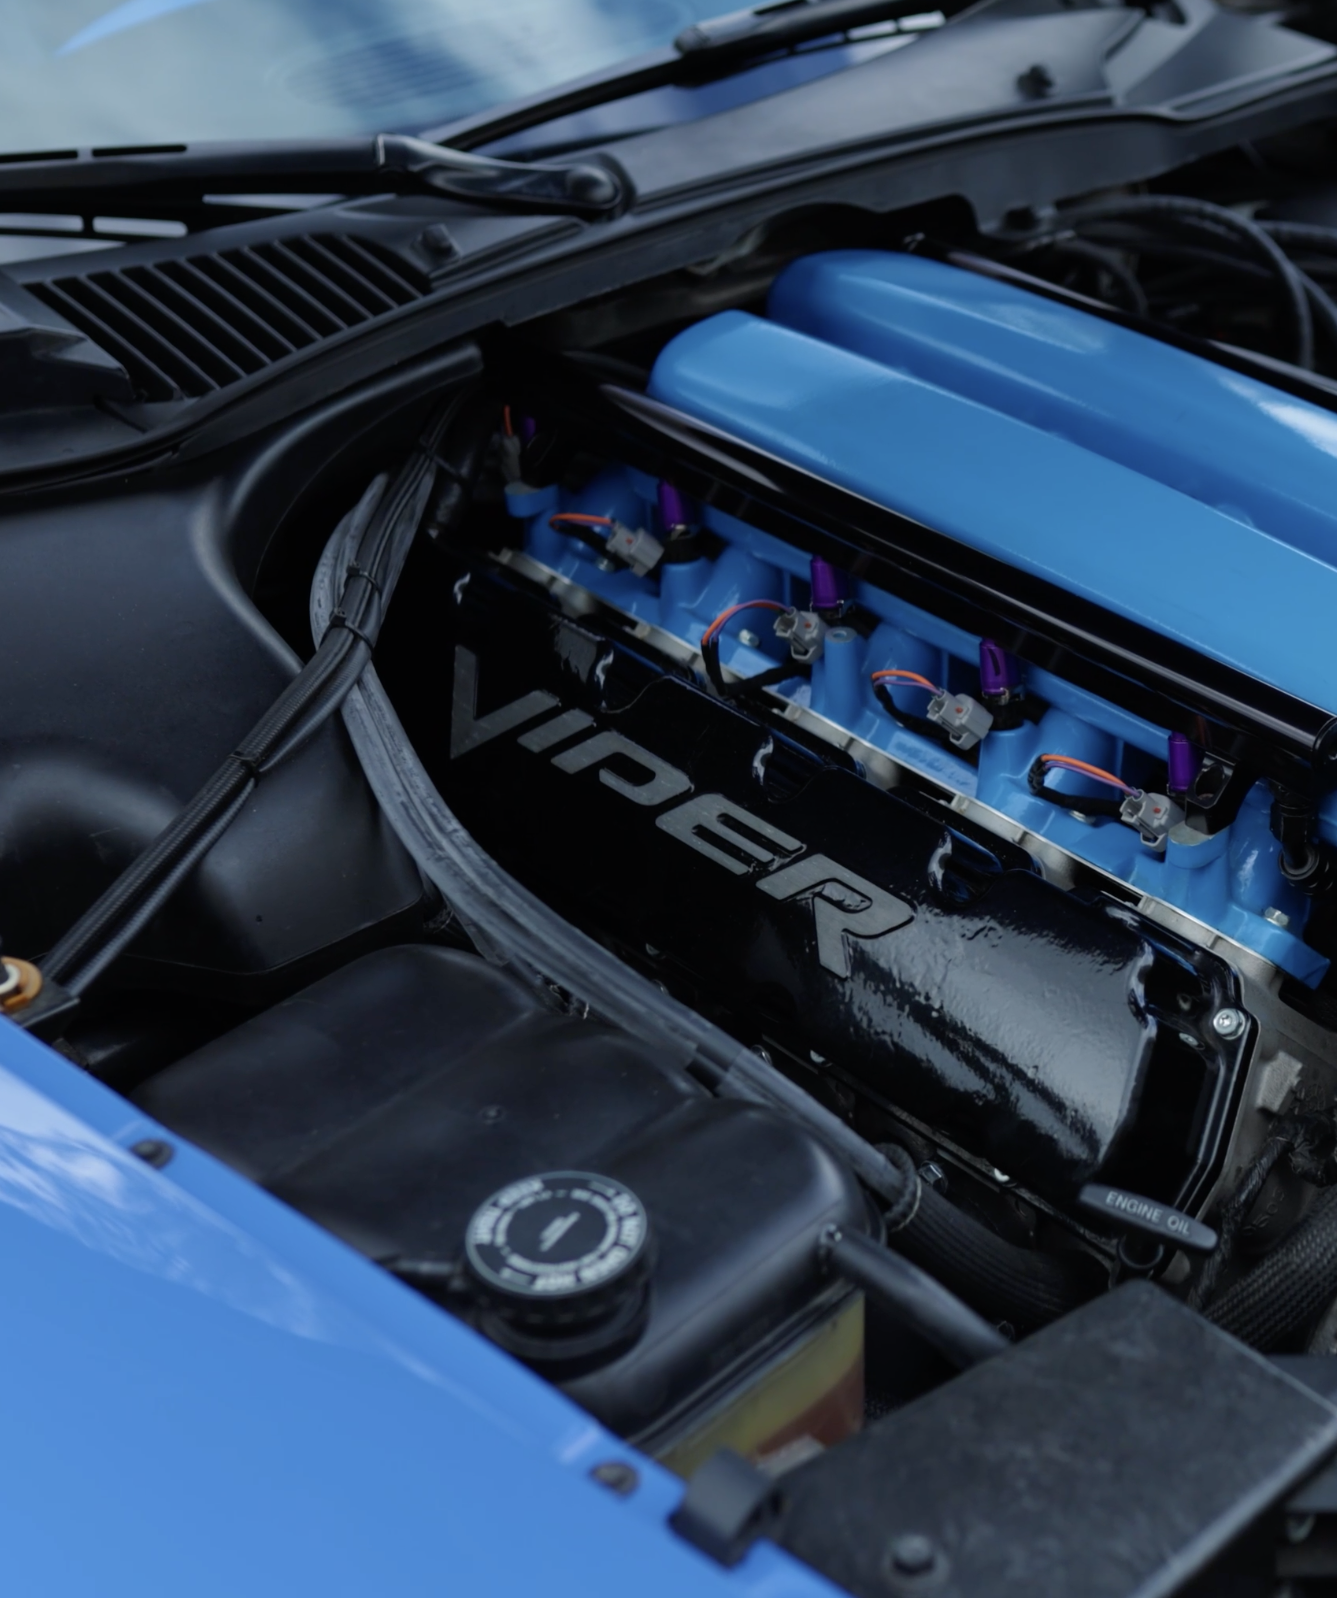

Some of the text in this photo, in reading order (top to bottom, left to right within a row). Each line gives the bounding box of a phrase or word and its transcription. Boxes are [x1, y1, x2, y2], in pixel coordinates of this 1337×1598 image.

[450, 644, 916, 979] VIPER
[1105, 1191, 1190, 1235] ENGINE OIL
